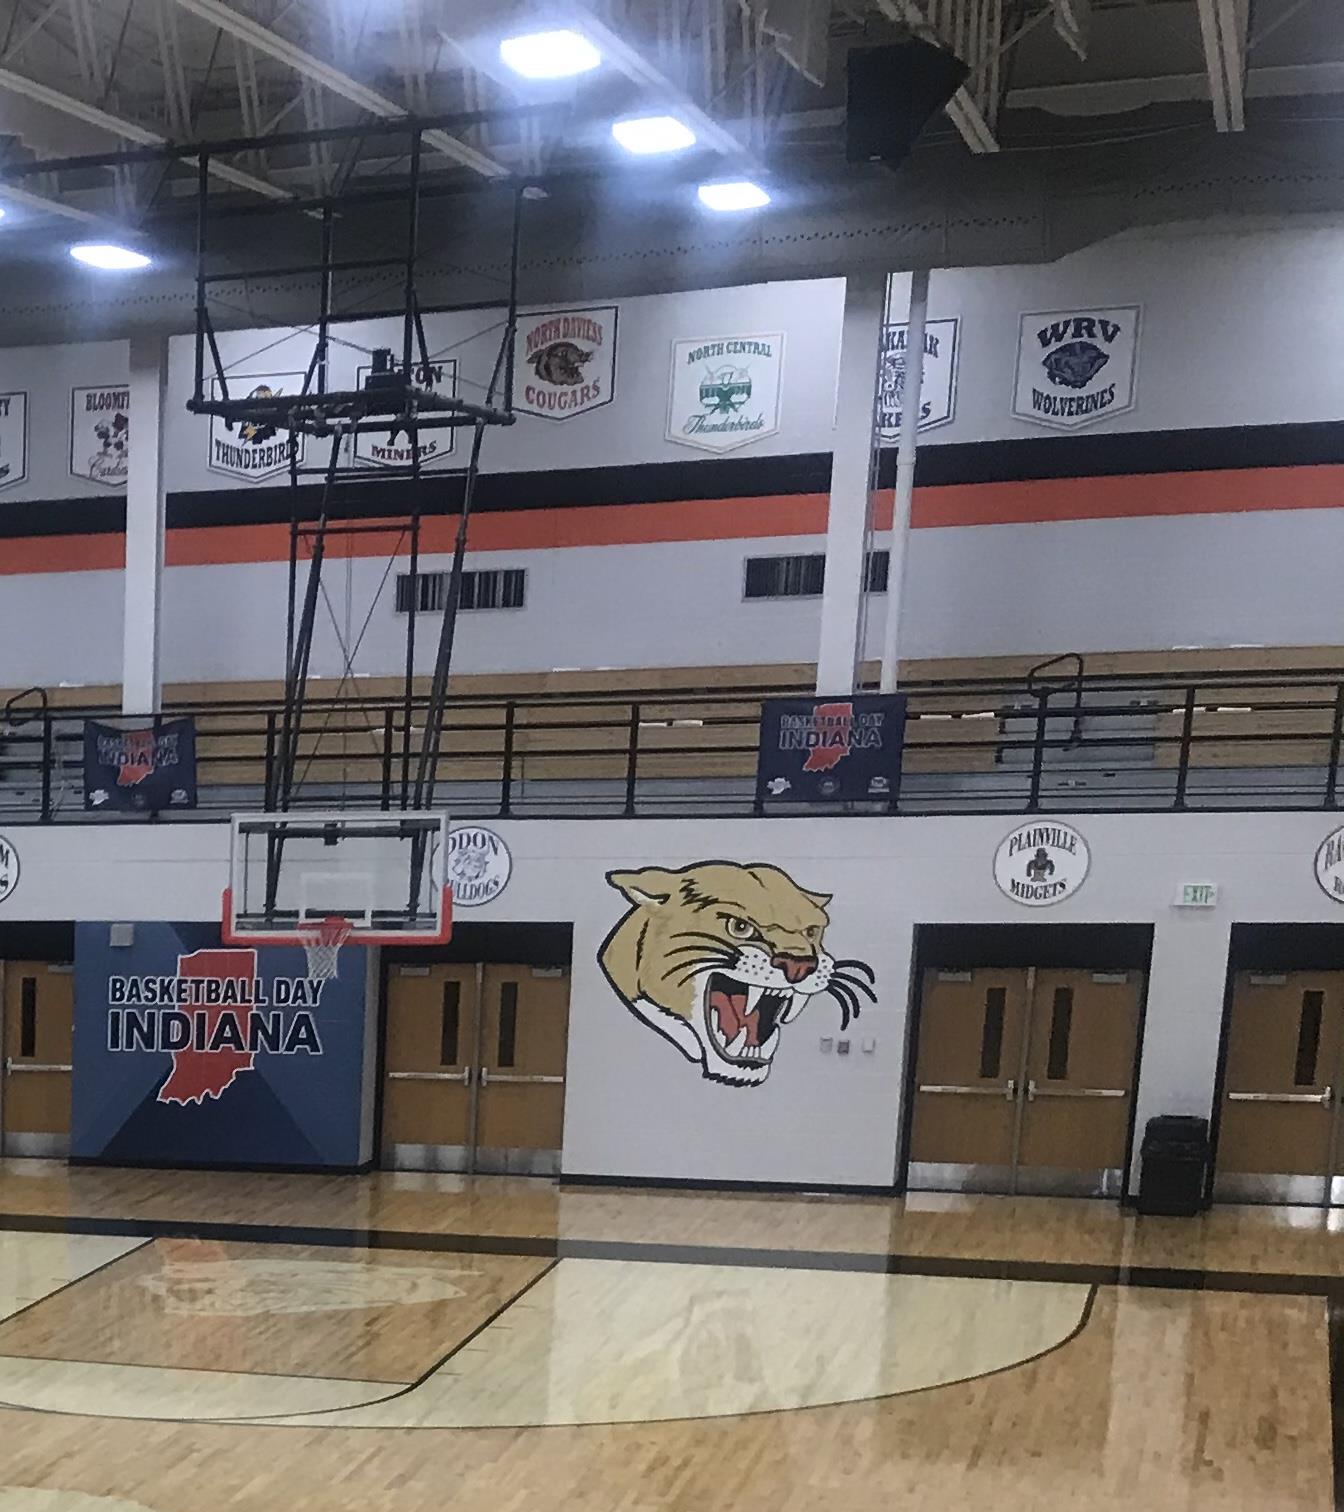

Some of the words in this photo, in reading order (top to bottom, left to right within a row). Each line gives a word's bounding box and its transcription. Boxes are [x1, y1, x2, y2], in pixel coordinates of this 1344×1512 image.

[526, 320, 561, 354] NORTH
[562, 317, 603, 346] DAVIESS
[1037, 317, 1121, 348] WRV
[687, 343, 724, 365] NORTH
[725, 341, 772, 358] CENTRAL
[524, 381, 601, 410] COUGARS
[1032, 383, 1116, 417] WOLVERINES
[682, 413, 765, 434] Thunderbirds
[779, 727, 883, 750] INDIANA
[1008, 827, 1077, 857] PLAINVILLE
[1010, 878, 1067, 901] MIDGETS
[109, 976, 269, 1006] BASKETBALL
[273, 976, 325, 1006] DAY
[108, 1009, 323, 1055] INDIANA
